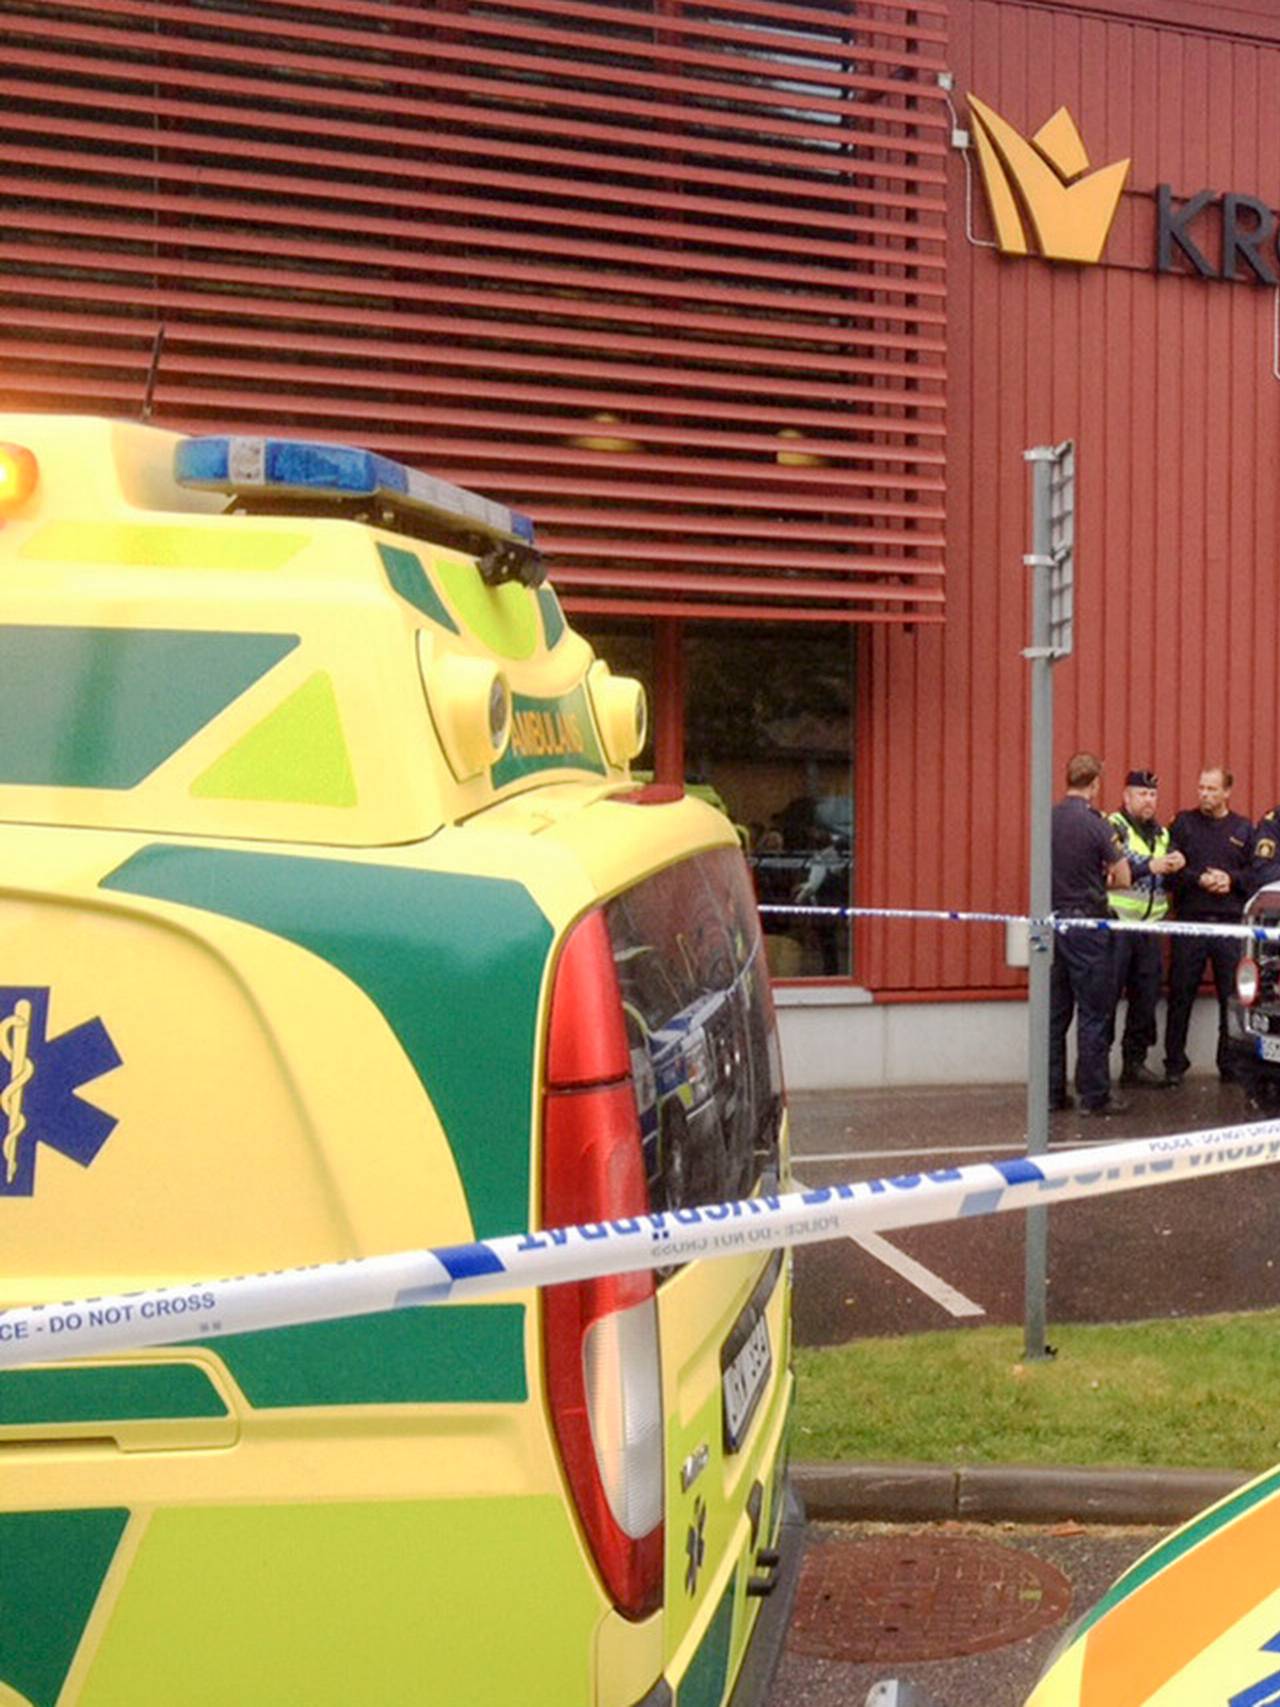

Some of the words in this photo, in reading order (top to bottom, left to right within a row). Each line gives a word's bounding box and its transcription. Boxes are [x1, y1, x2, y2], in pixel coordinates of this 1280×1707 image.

[49, 1313, 83, 1334] DO
[89, 1305, 134, 1327] NOT
[140, 1292, 216, 1318] CROSS
